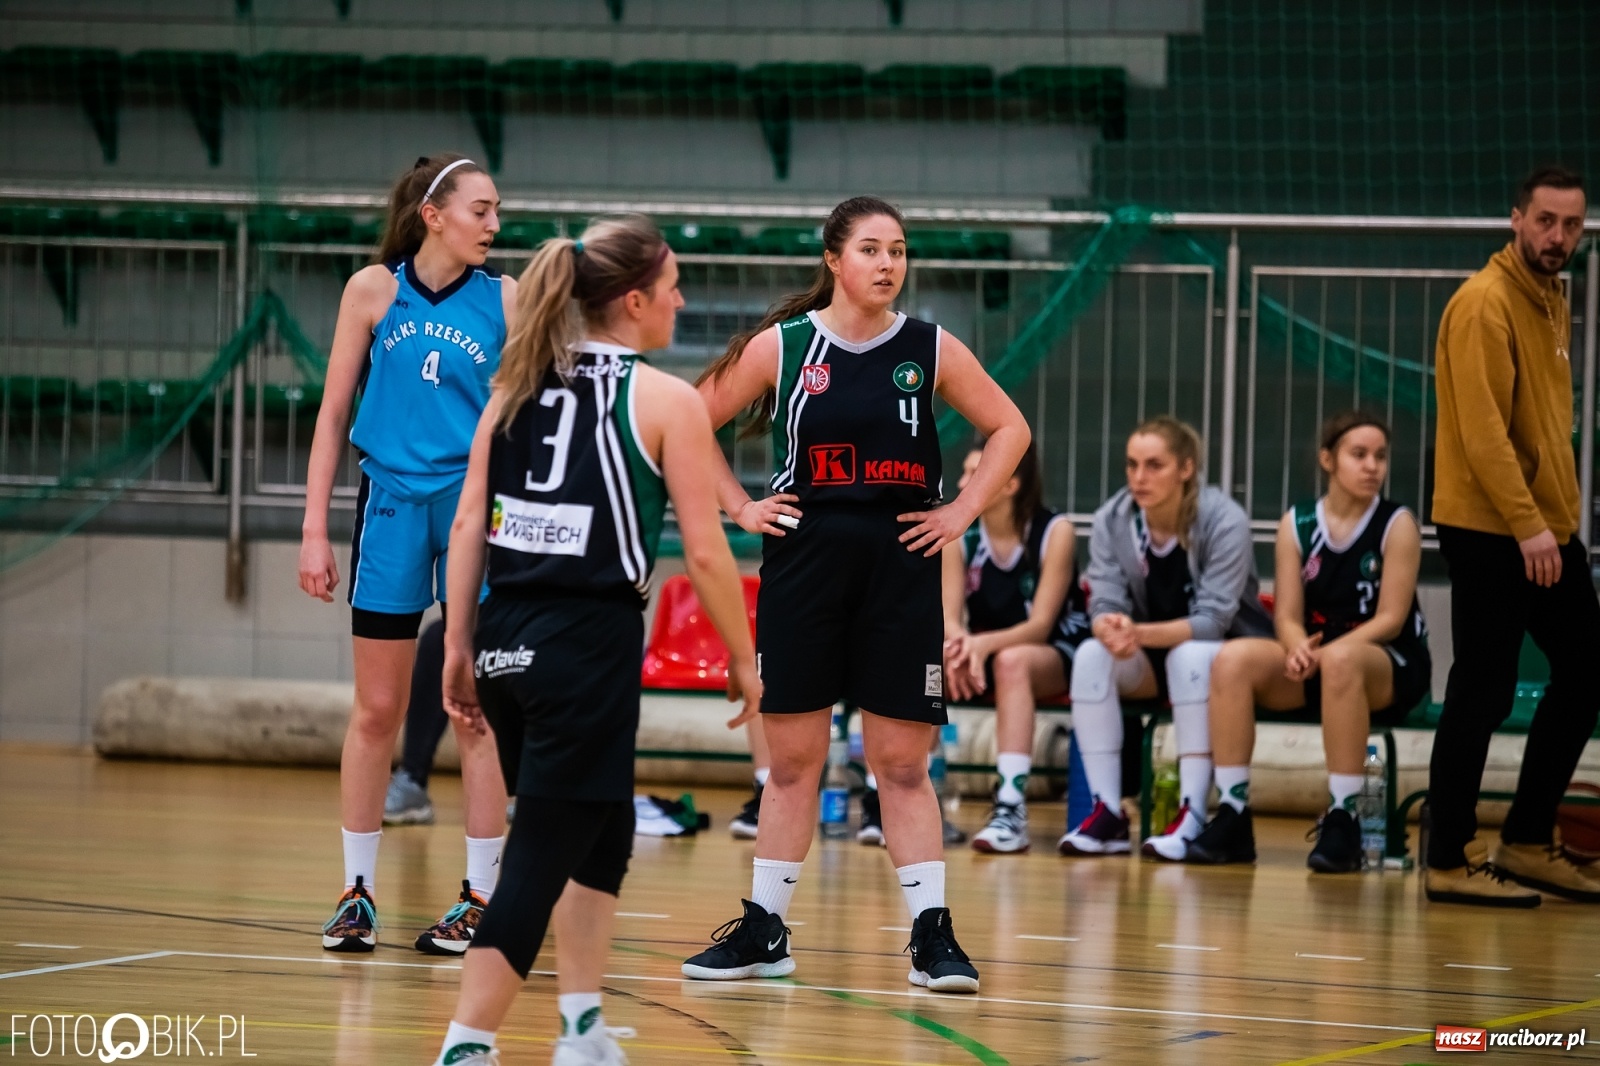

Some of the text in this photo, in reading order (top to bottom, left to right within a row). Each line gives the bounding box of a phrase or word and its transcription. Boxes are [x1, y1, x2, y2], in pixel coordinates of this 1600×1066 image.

[383, 320, 488, 365] MLKS RZESZÓW
[421, 350, 440, 389] 4
[898, 396, 919, 437] 4
[525, 387, 579, 493] 3
